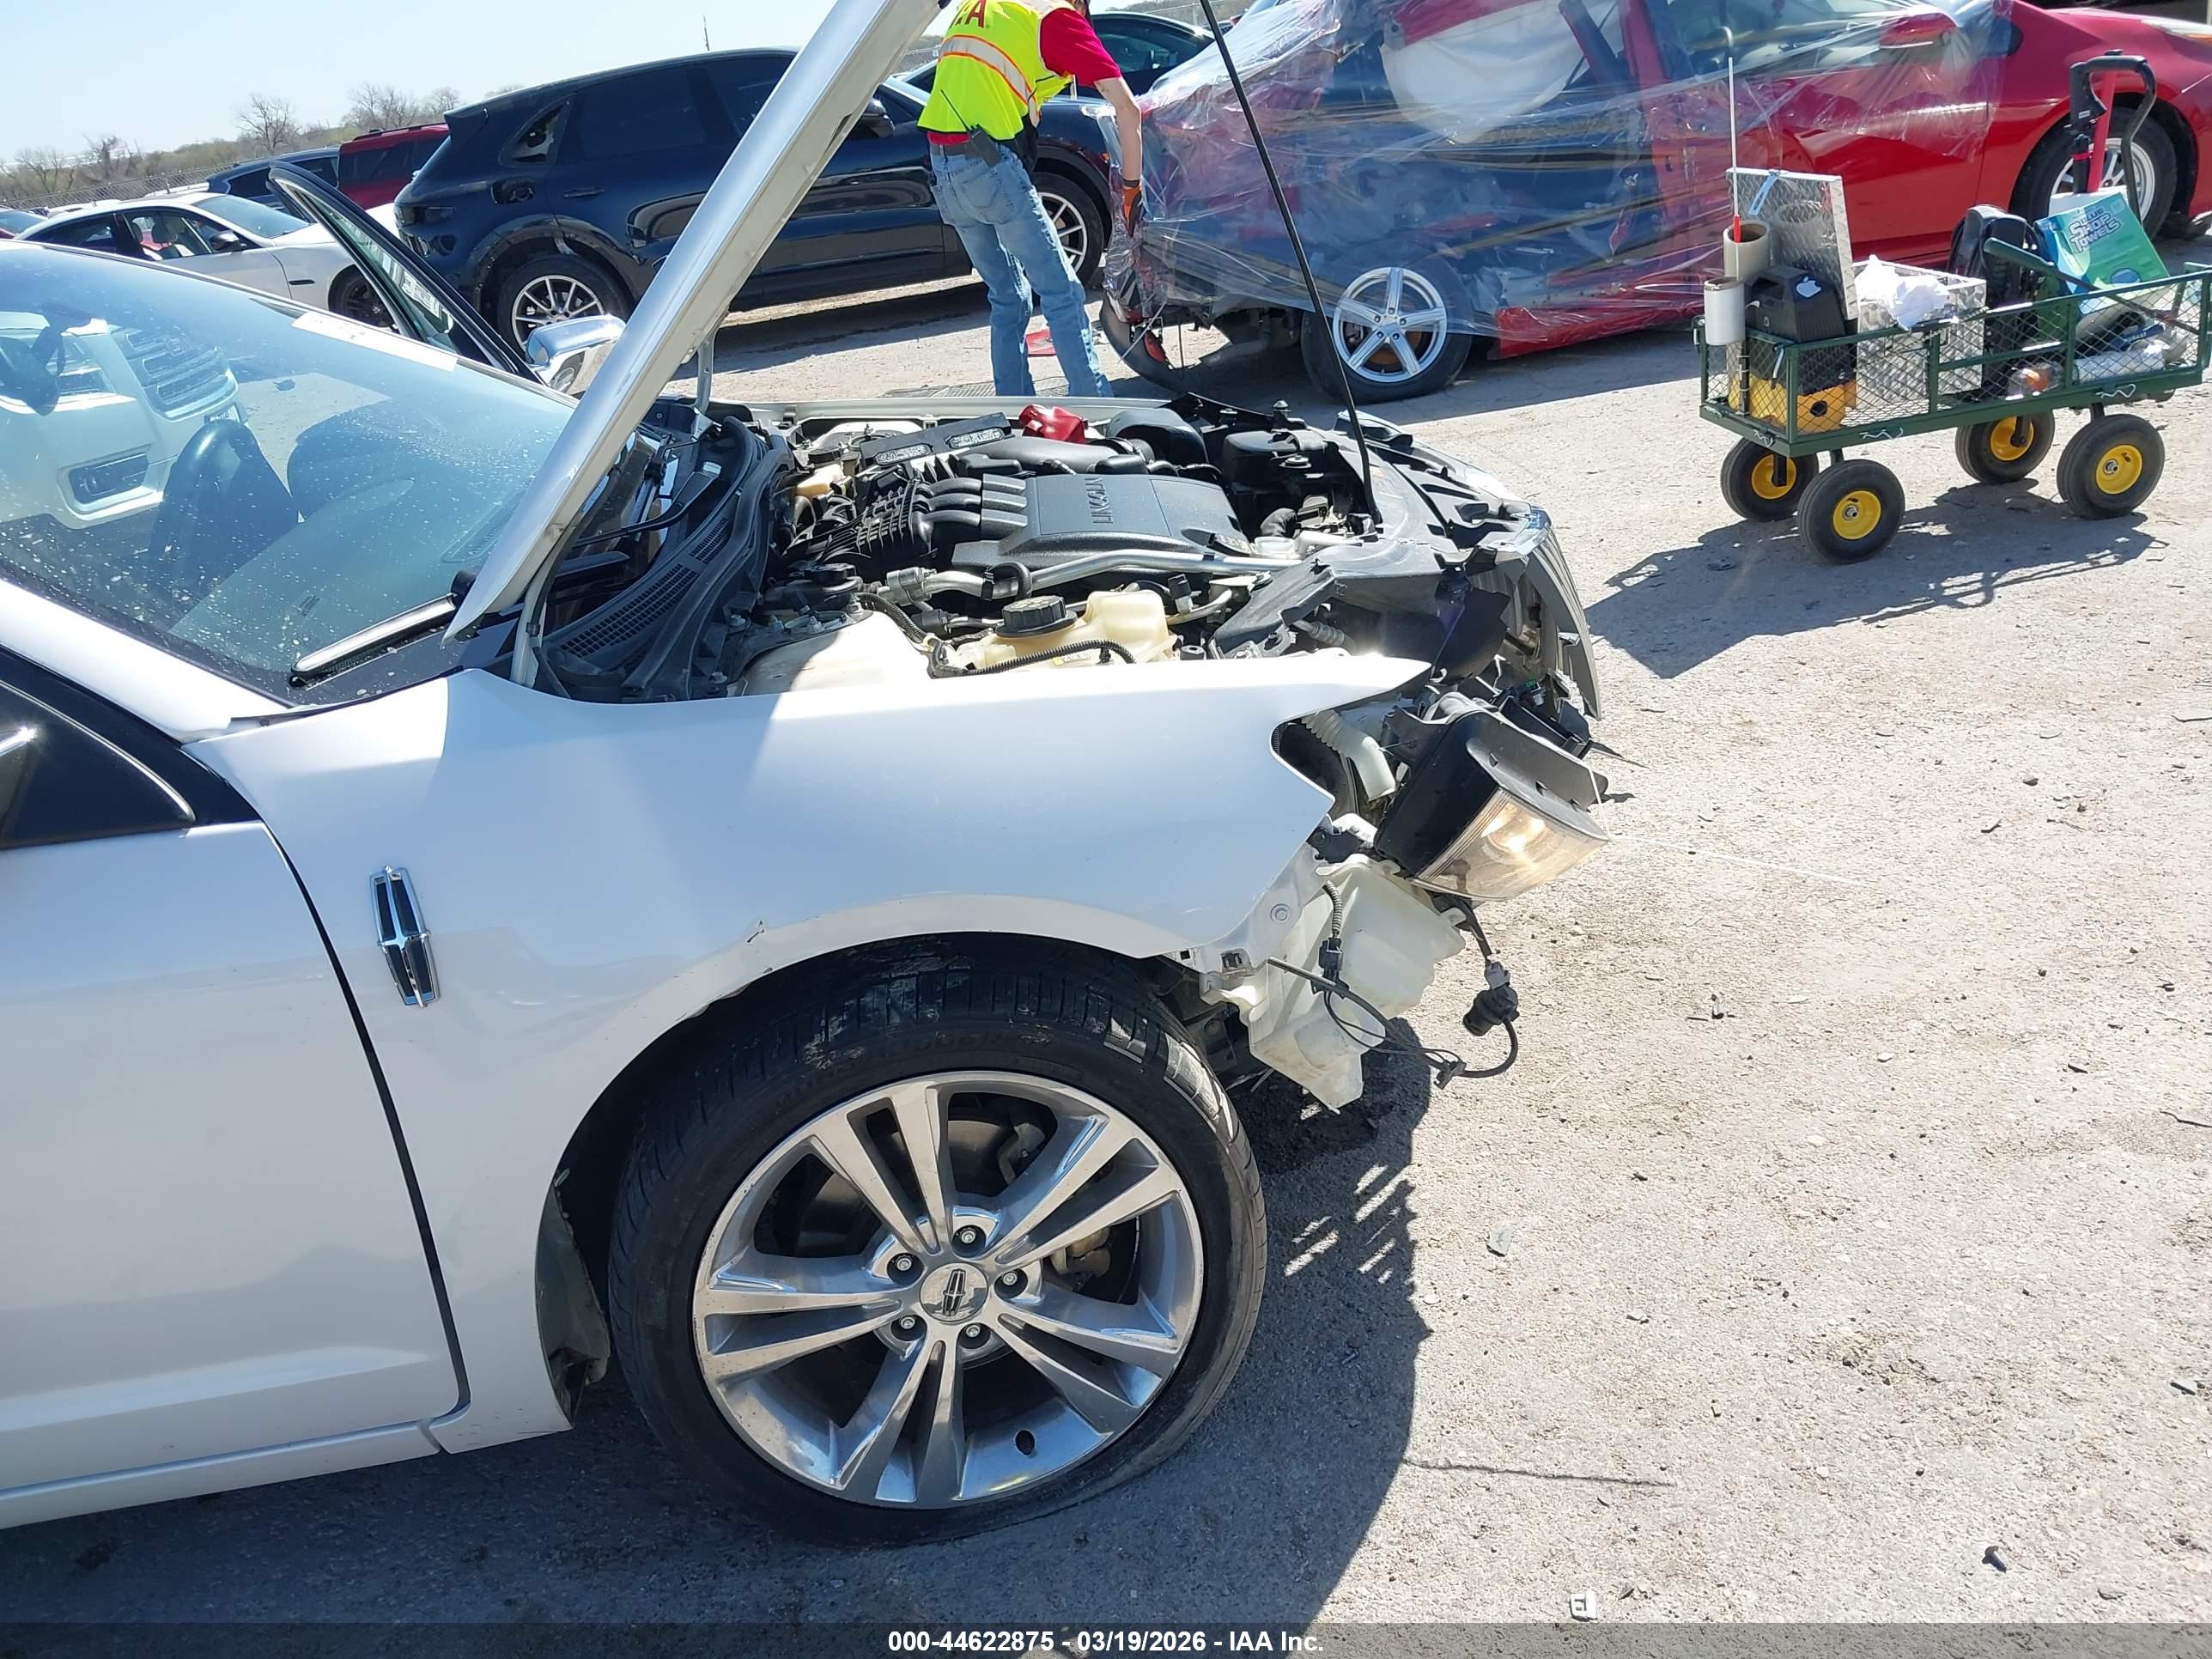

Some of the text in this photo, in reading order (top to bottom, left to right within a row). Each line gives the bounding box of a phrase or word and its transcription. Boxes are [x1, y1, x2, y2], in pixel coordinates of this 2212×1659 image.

[2069, 212, 2112, 238] SHOP
[2070, 218, 2122, 252] TOWELS
[1085, 477, 1114, 524] LINCOLN
